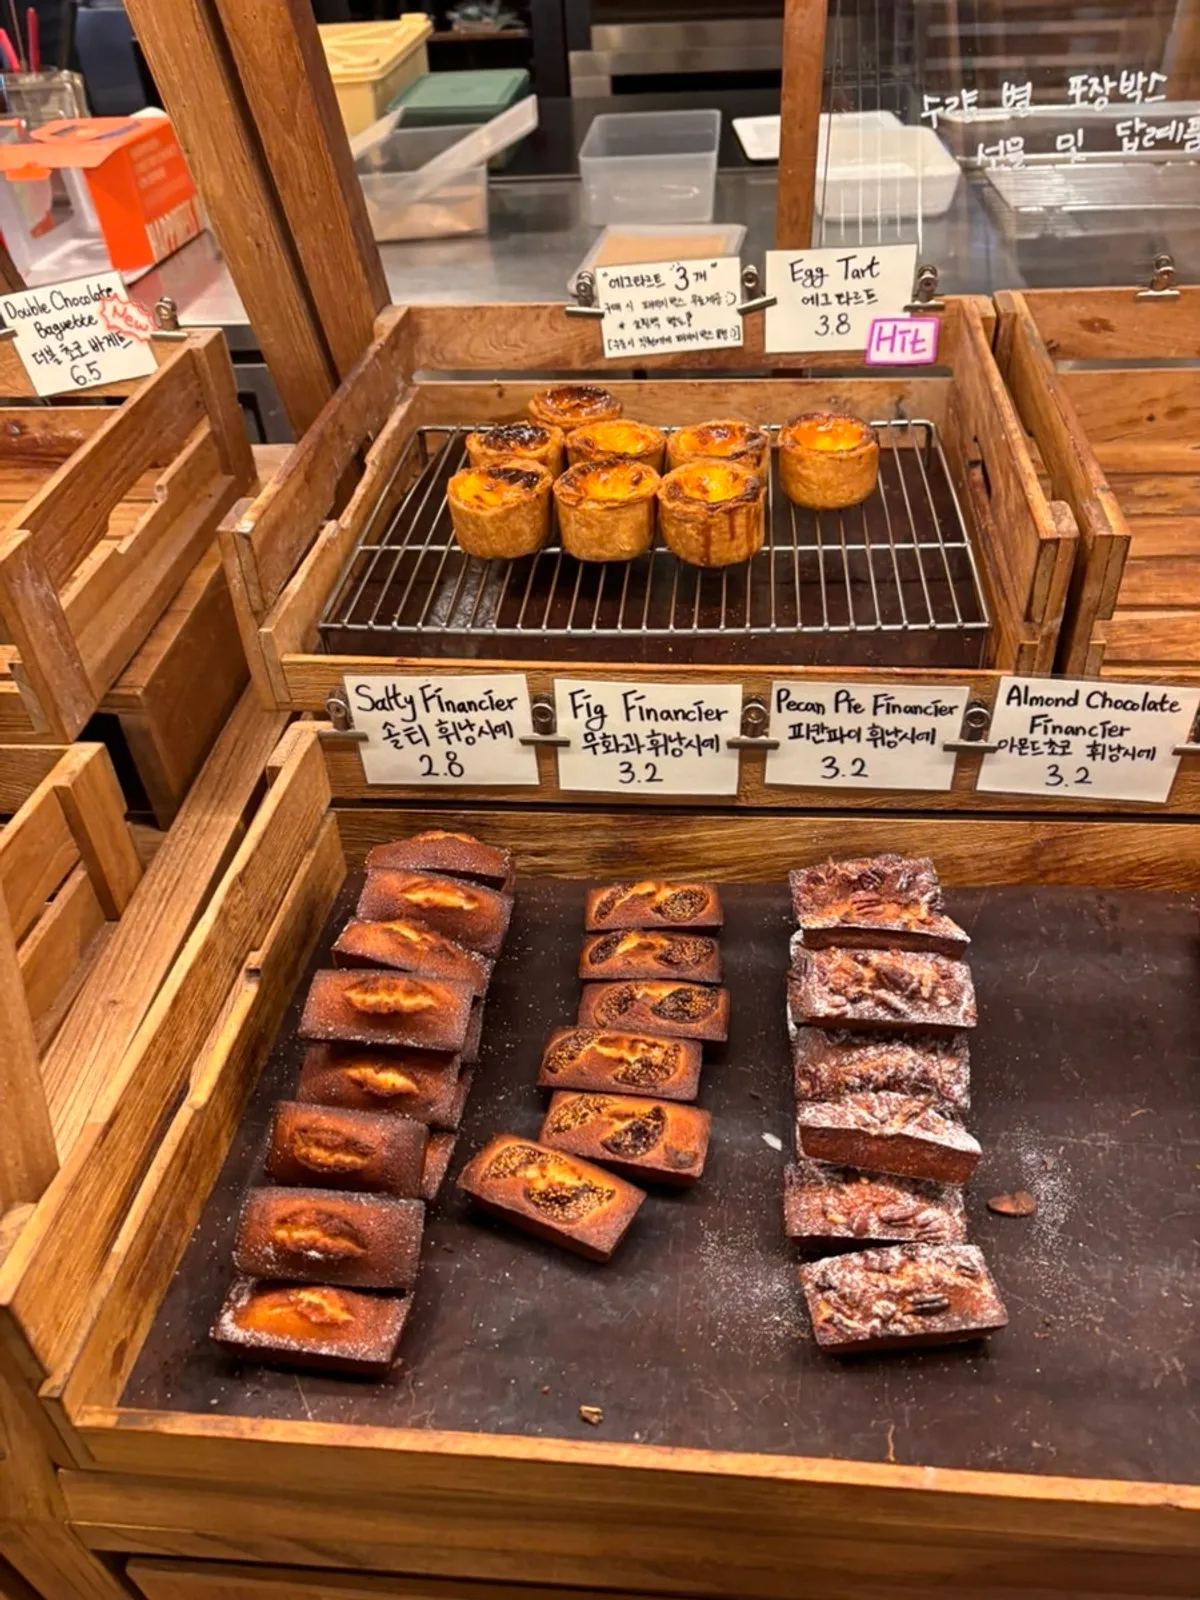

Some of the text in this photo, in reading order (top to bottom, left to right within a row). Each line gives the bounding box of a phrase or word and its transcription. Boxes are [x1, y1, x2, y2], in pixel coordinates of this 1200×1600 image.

[921, 89, 978, 128] 수량
[977, 136, 1026, 169] 선물
[1056, 128, 1087, 164] 및
[788, 255, 881, 289] Egg Tart
[4, 284, 113, 320] Double Chocolate
[801, 289, 879, 307] 에그타르트
[33, 314, 99, 341] Baguette
[112, 305, 149, 332] New
[814, 312, 851, 337] 3.8
[876, 324, 927, 355] Hit
[31, 345, 63, 366] 더블
[70, 361, 102, 386] 6.5
[355, 683, 518, 723] Salty Financier
[568, 688, 729, 732] Fig Financier
[776, 688, 960, 718] Pecan Pie Financier
[1005, 685, 1181, 713] Almond Chocolate
[382, 721, 431, 750] 솔티
[787, 722, 937, 749] 피칸파이 휘낭시에
[1028, 714, 1131, 739] Financier
[582, 731, 645, 756] 무화과
[1086, 740, 1157, 763] 휘낭시에
[419, 750, 465, 778] 2.8
[618, 761, 664, 785] 3.2
[821, 755, 869, 780] 3.2
[1044, 764, 1093, 788] 3.2
